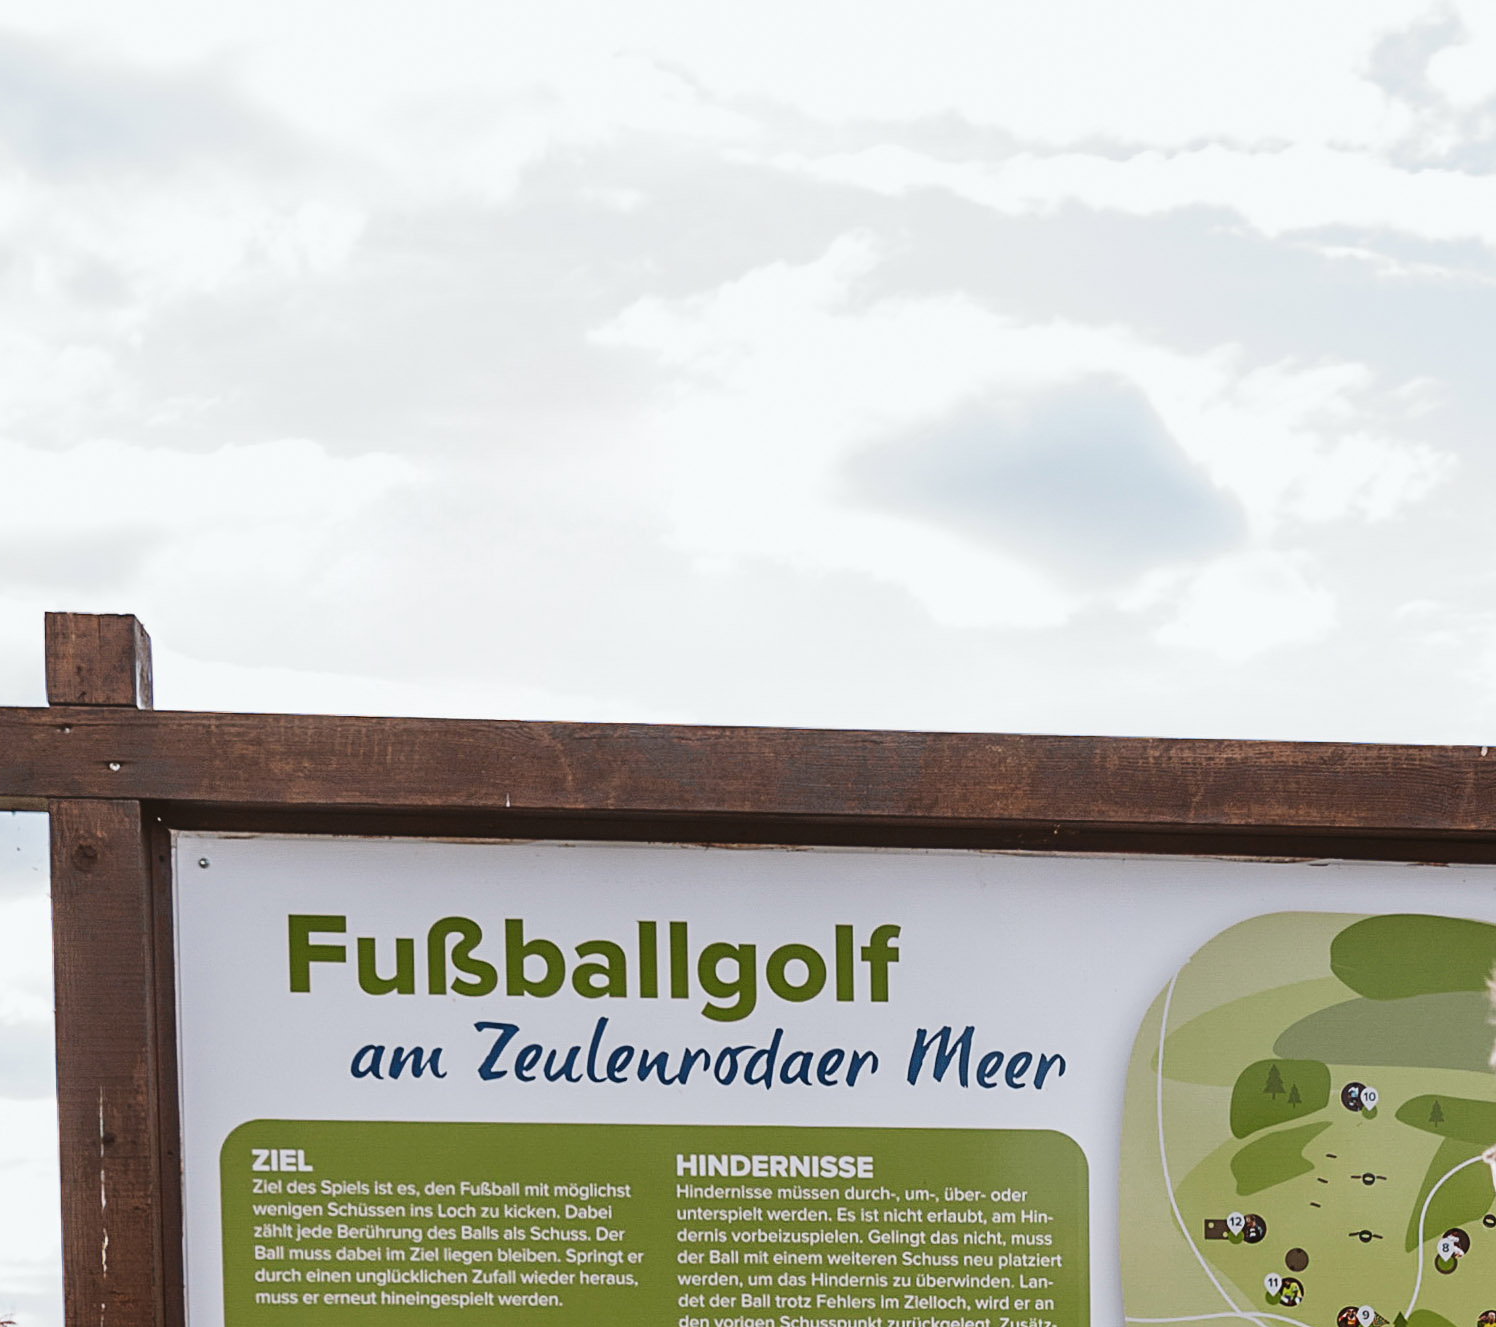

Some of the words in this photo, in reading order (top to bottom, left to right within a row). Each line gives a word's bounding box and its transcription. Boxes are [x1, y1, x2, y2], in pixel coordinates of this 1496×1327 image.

[288, 914, 901, 1022] Fußballgolf
[351, 1044, 447, 1080] am
[474, 1016, 878, 1090] Zeulenrodaer
[907, 1025, 1066, 1090] Meer
[1364, 1092, 1376, 1102] 10
[252, 1149, 313, 1172] ZIEL
[677, 1153, 873, 1179] HINDERNISSE
[253, 1178, 282, 1194] Ziel
[287, 1180, 316, 1195] des
[321, 1180, 370, 1197] Spiels
[374, 1180, 393, 1195] ist
[397, 1184, 420, 1197] es,
[424, 1181, 455, 1196] den
[460, 1181, 520, 1197] Fußball
[525, 1182, 549, 1197] mit
[554, 1182, 631, 1200] möglichst
[677, 1184, 772, 1200] Hindernisse
[778, 1185, 839, 1200] müssen
[845, 1186, 900, 1202] durch-,
[905, 1189, 939, 1202] um-,
[945, 1186, 986, 1202] über-
[991, 1187, 1027, 1203] oder
[253, 1202, 323, 1219] wenigen
[328, 1201, 405, 1218] Schüssen
[410, 1204, 433, 1218] ins
[438, 1203, 476, 1218] Loch
[481, 1206, 499, 1219] zu
[504, 1204, 560, 1219] kicken.
[565, 1204, 612, 1219] Dabei
[1229, 1216, 1242, 1227] 12
[254, 1223, 292, 1238] zählt
[296, 1223, 332, 1241] jede
[337, 1224, 422, 1243] Berührung
[427, 1225, 456, 1241] des
[461, 1225, 499, 1241] Balls
[504, 1226, 526, 1241] als
[530, 1225, 591, 1241] Schuss.
[596, 1226, 624, 1242] Der
[677, 1228, 727, 1242] dernis
[732, 1229, 863, 1246] vorbeizuspielen.
[868, 1229, 925, 1248] Gelingt
[930, 1230, 958, 1245] das
[964, 1230, 1006, 1247] nicht,
[1011, 1234, 1052, 1246] muss
[1442, 1243, 1450, 1253] 8
[1267, 1277, 1278, 1288] 11
[1362, 1310, 1370, 1320] 9
